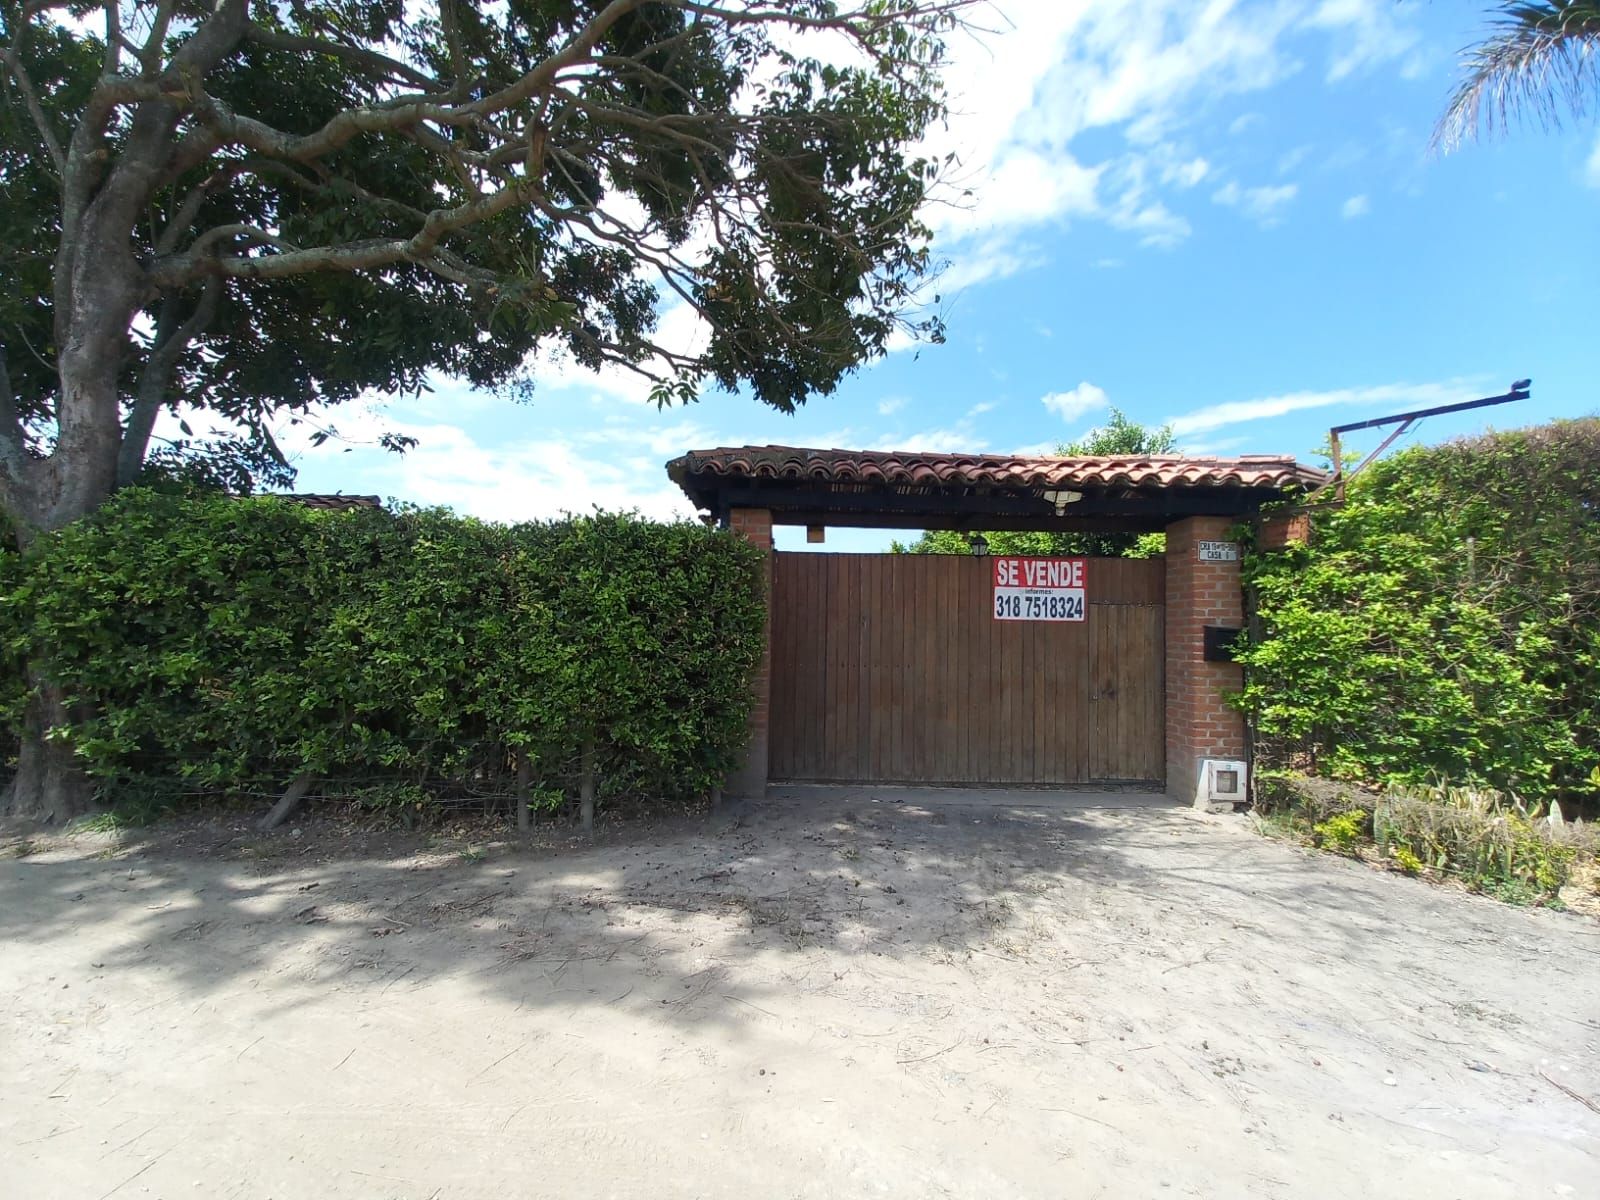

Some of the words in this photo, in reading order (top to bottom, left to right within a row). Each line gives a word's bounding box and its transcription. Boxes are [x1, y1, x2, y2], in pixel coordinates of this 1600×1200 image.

[997, 559, 1019, 586] SE
[1023, 560, 1083, 587] VENDE
[996, 595, 1021, 617] 318
[1025, 596, 1083, 619] 7518324
